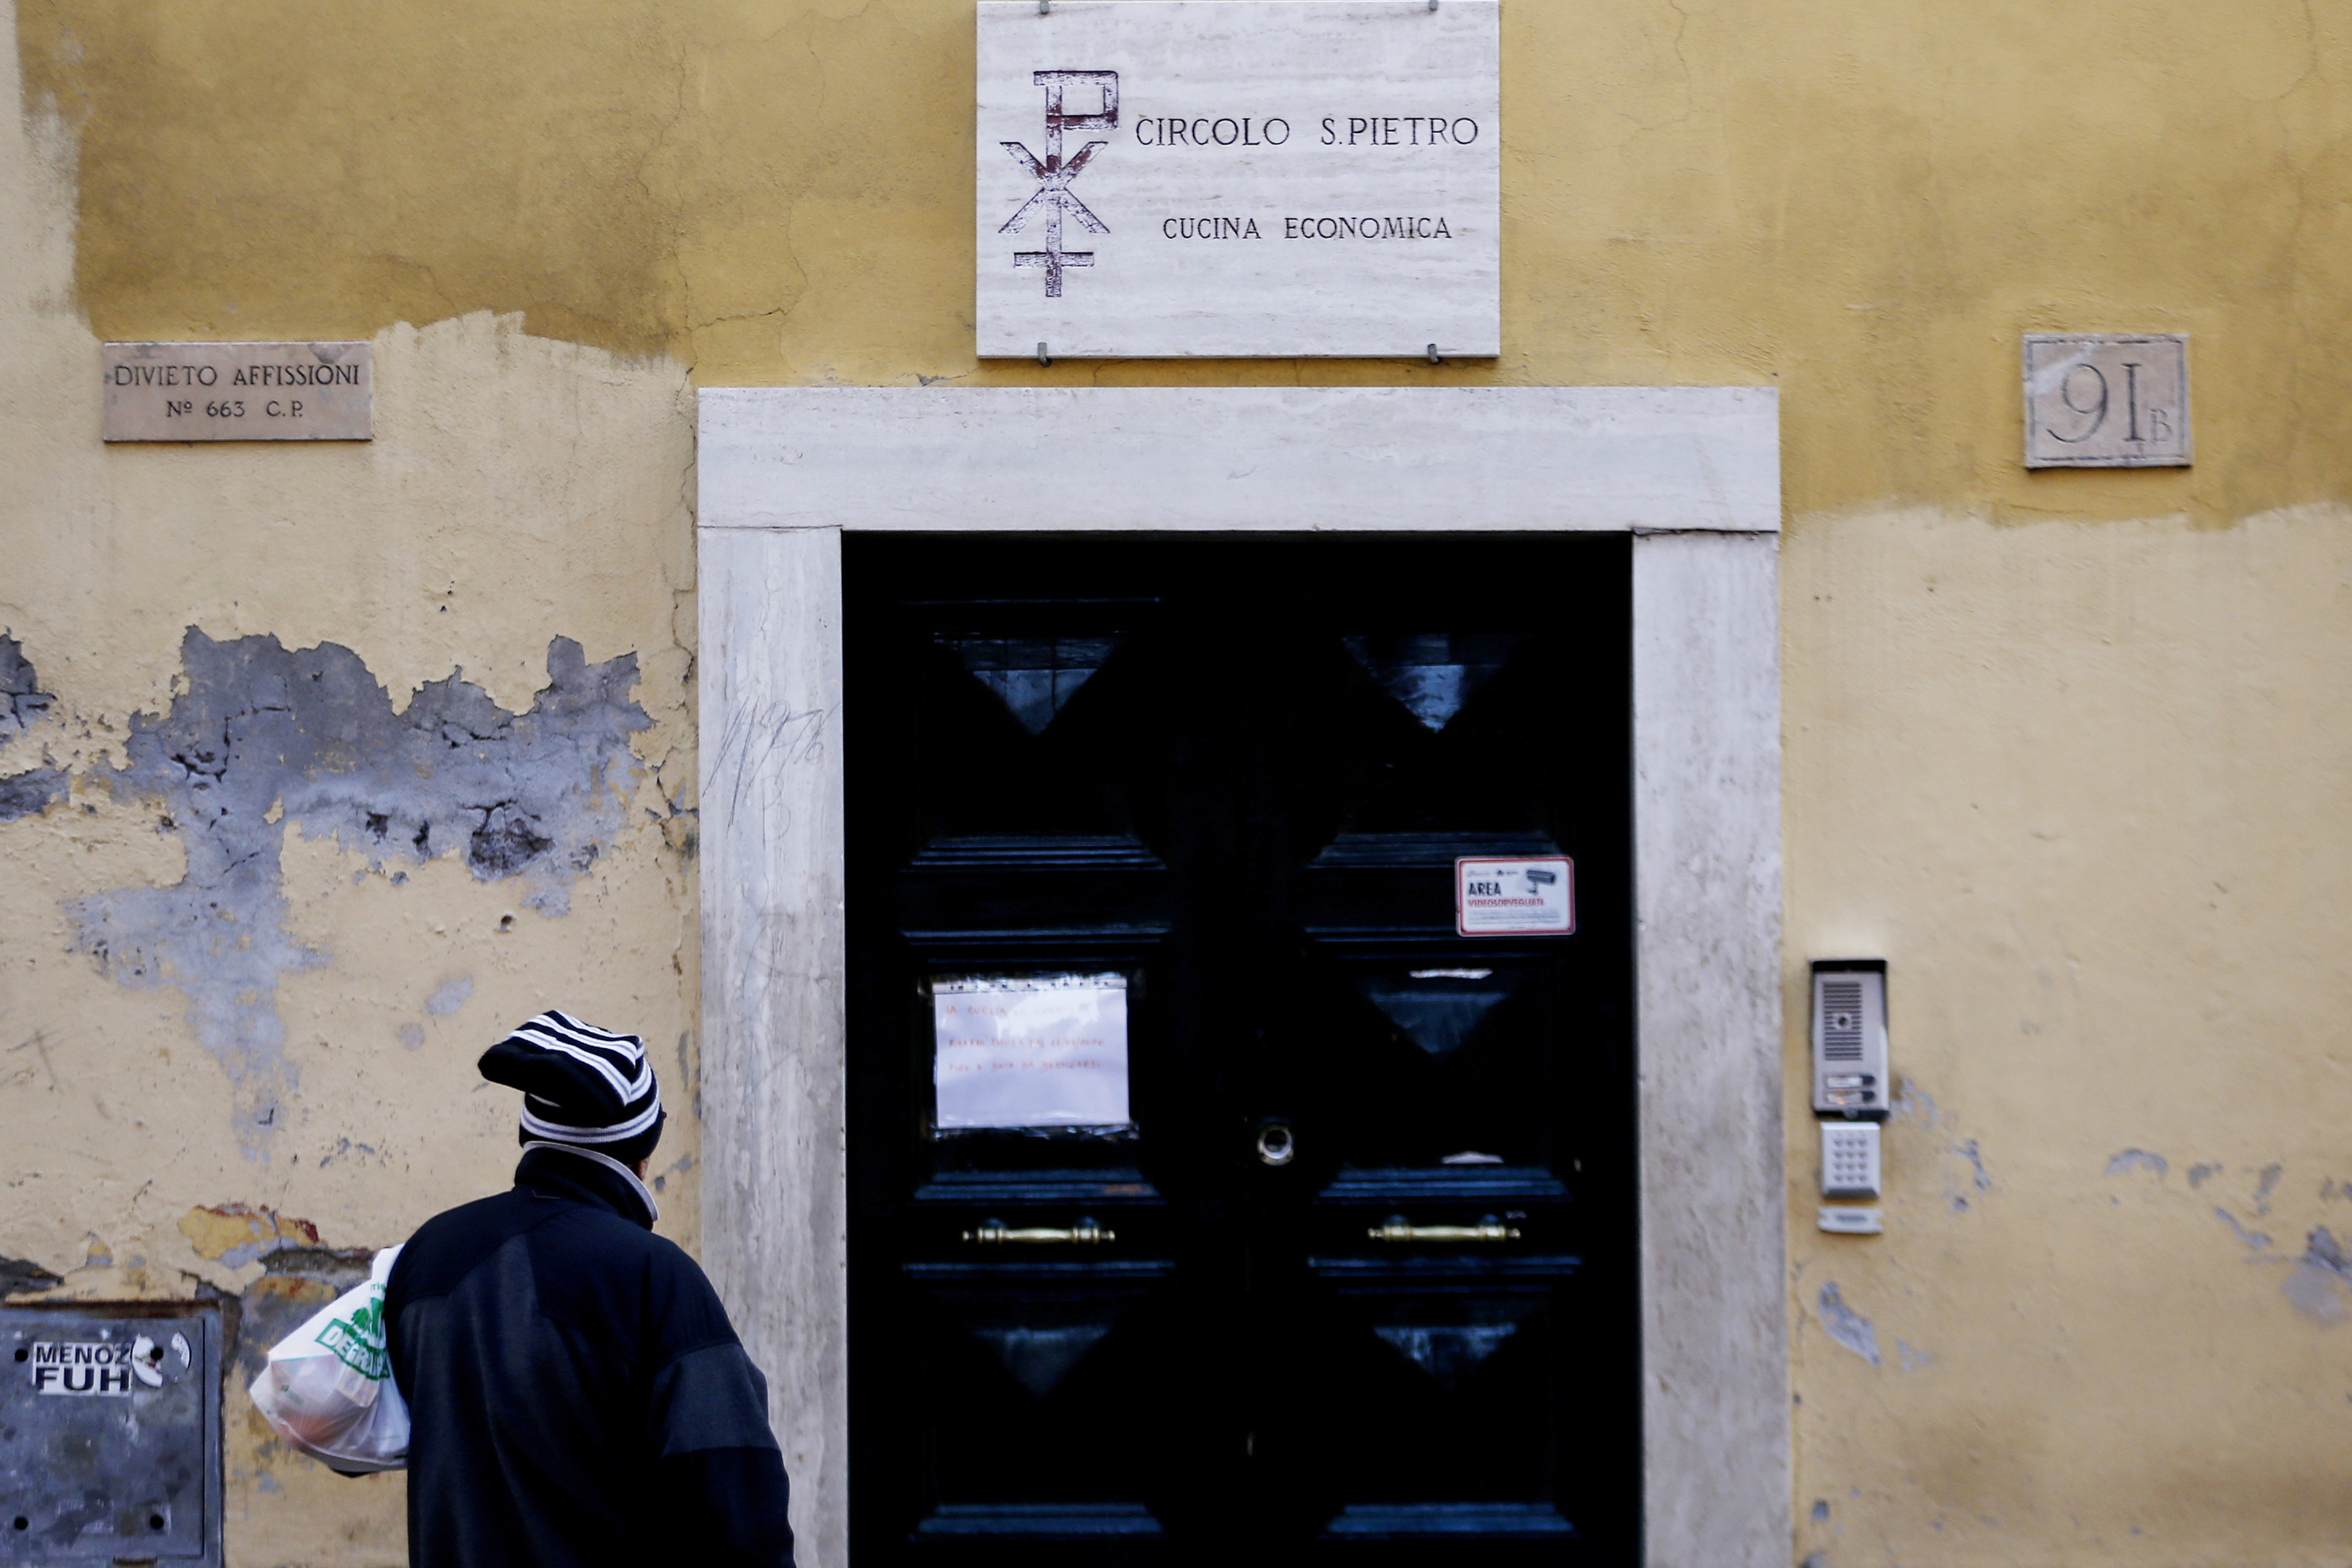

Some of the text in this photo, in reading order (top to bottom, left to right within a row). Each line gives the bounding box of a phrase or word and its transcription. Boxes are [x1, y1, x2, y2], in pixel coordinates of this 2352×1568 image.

[1136, 118, 1290, 146] CIRCOLO
[1163, 217, 1452, 240] CUCINA ECONOMICA
[115, 364, 359, 386] DIVIETO AFFISSIONI
[206, 401, 245, 417] 663
[1468, 882, 1501, 896] AREA
[36, 1367, 130, 1391] FUH
